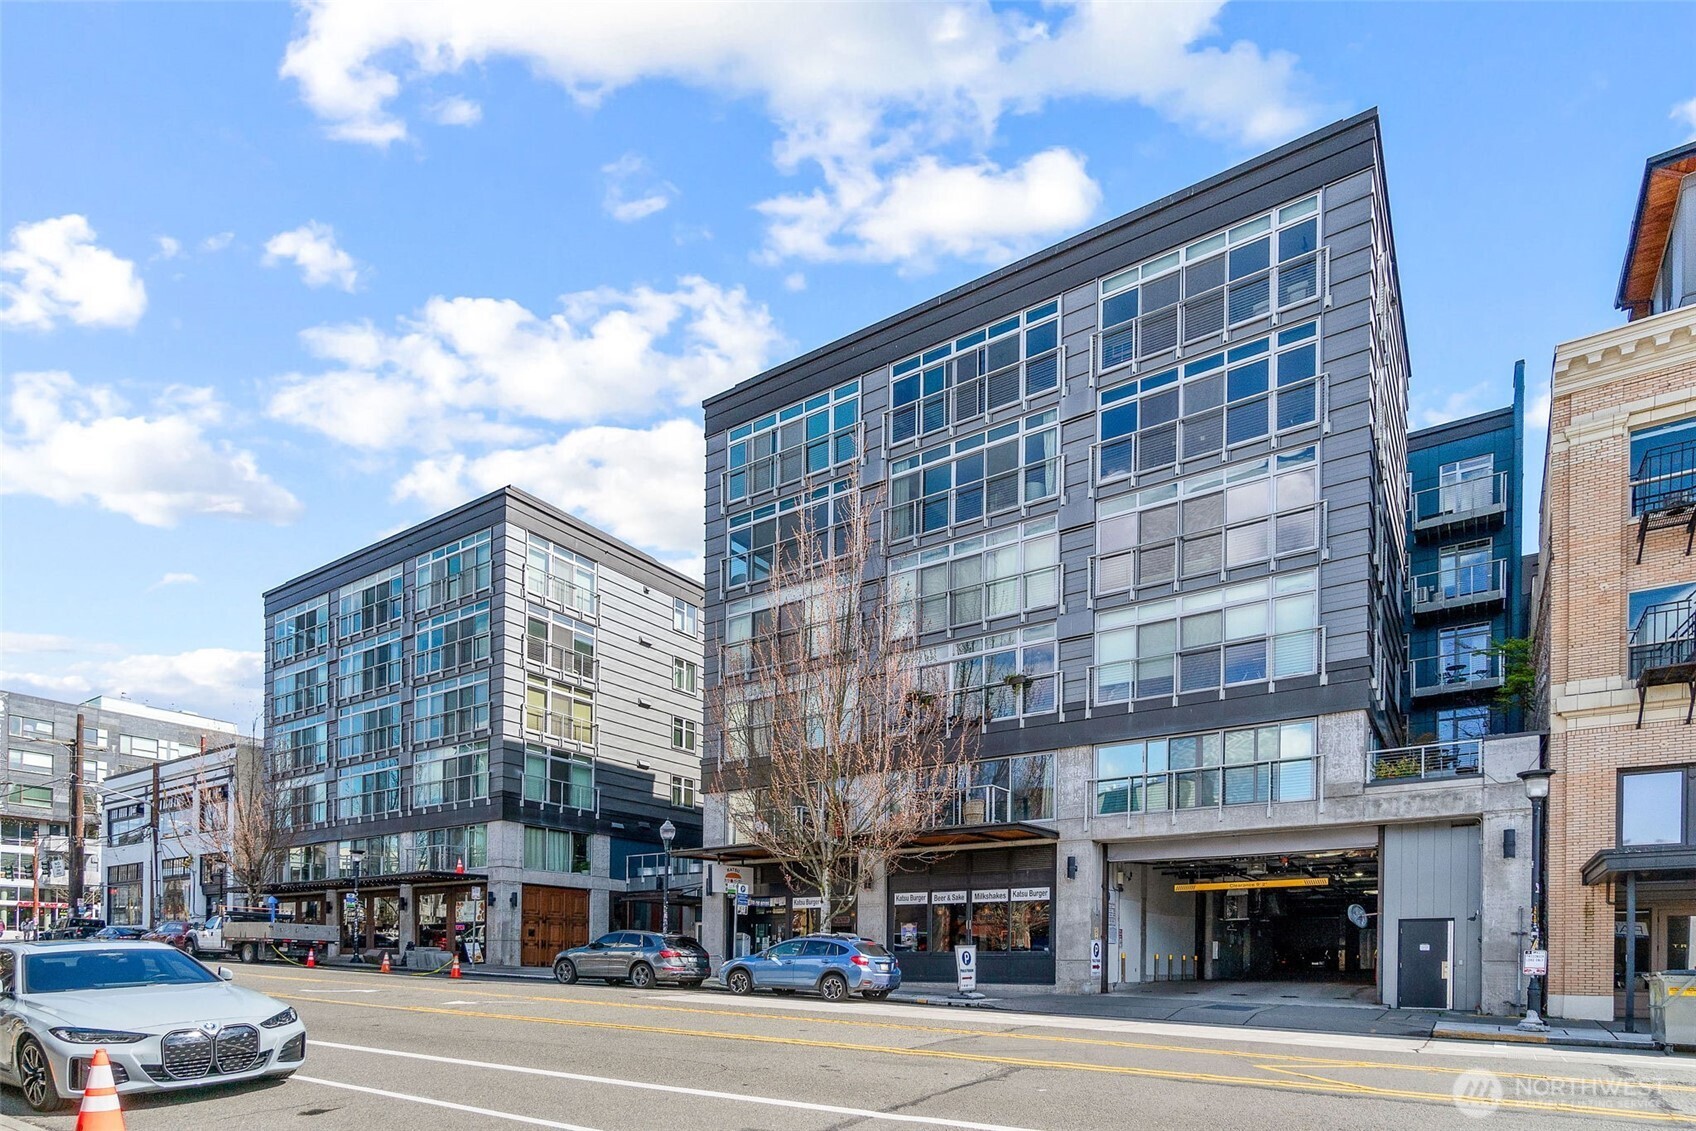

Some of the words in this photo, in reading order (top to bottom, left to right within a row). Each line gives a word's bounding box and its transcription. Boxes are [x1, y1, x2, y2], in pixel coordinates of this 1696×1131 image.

[974, 892, 1006, 900] Milkshakes
[1012, 890, 1028, 898] Katsu
[1029, 889, 1048, 898] Burger
[910, 894, 926, 902] Burger
[934, 894, 946, 902] Beer
